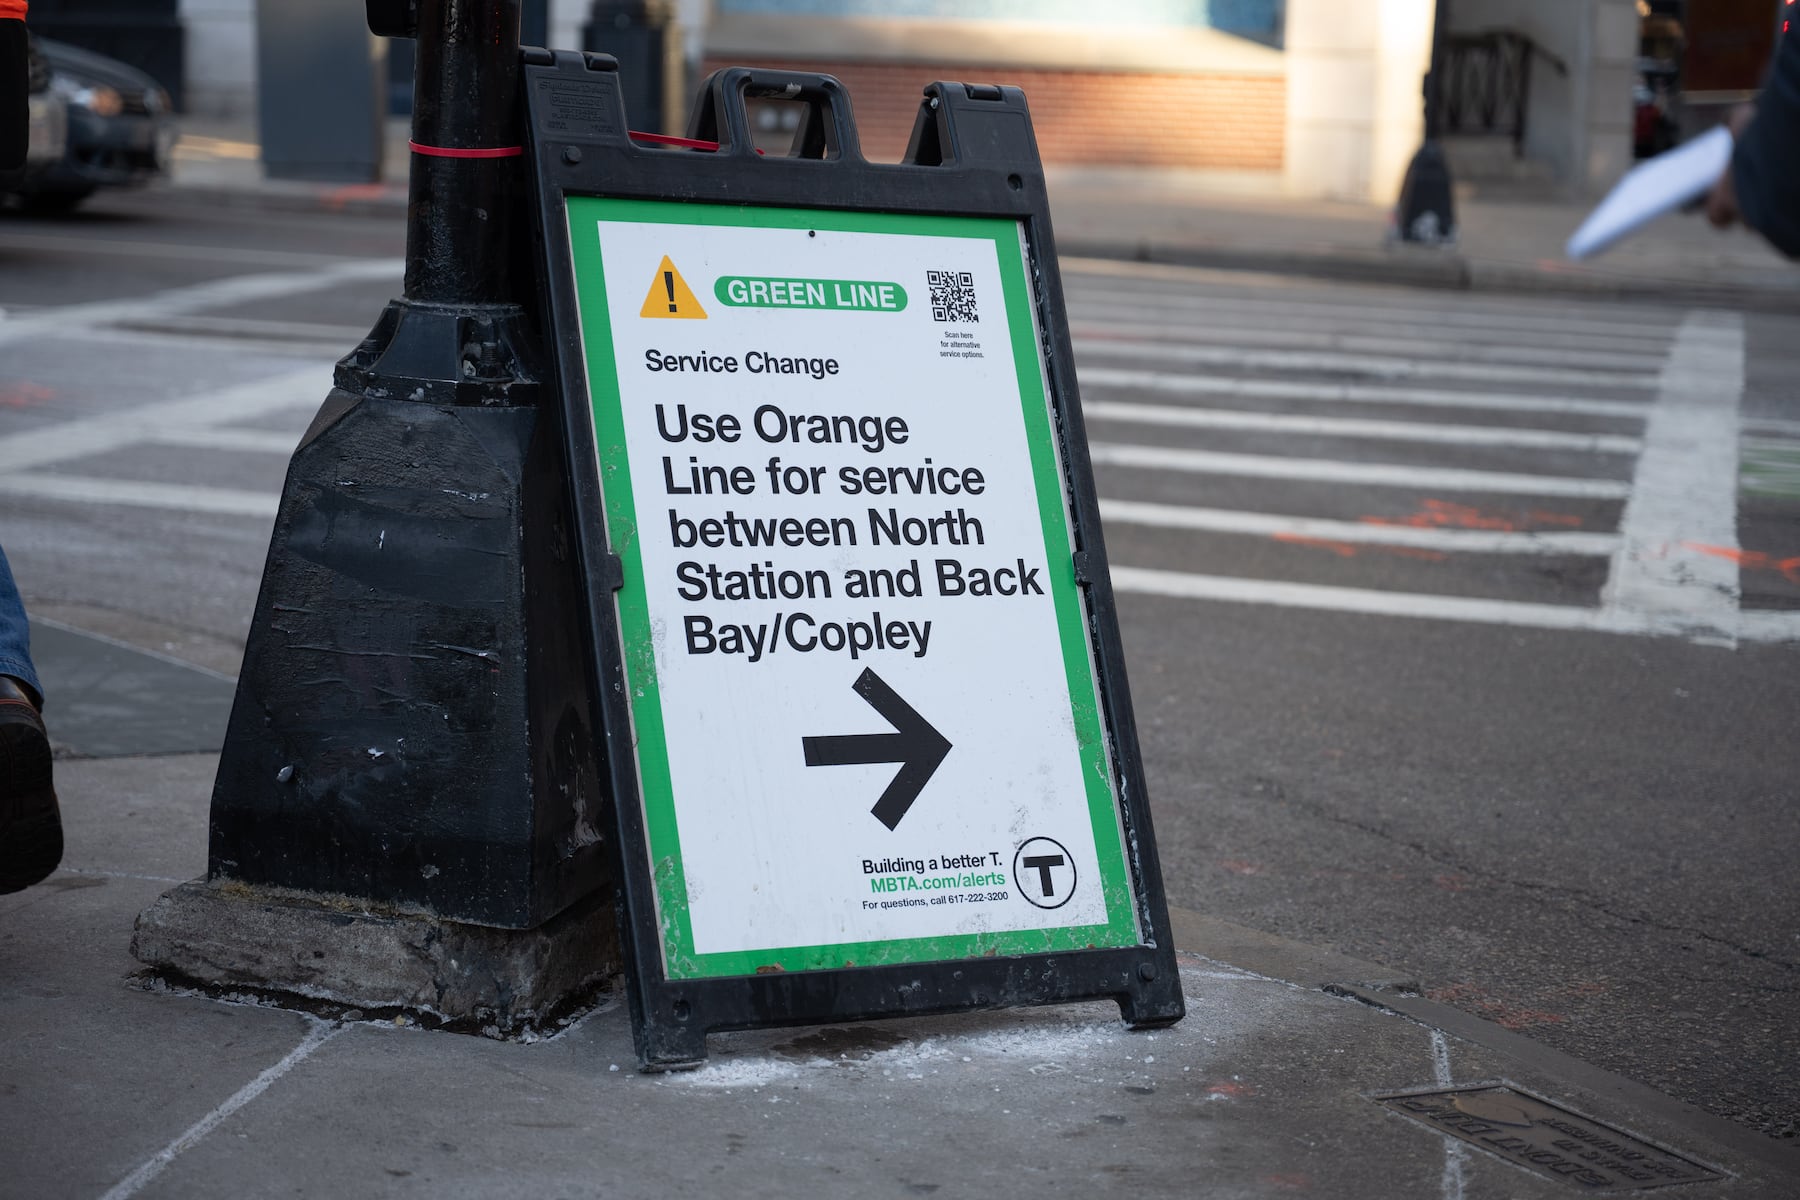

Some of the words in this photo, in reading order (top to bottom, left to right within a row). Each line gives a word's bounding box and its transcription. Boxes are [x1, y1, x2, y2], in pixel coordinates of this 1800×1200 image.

[728, 278, 827, 305] GREEN
[835, 281, 898, 308] LINE
[944, 331, 960, 339] Scan
[950, 341, 981, 349] alternative
[646, 349, 738, 372] Service
[746, 352, 838, 379] Change
[939, 350, 961, 358] service
[961, 351, 984, 360] options.
[655, 404, 741, 442] Use
[754, 405, 908, 453] Orange
[663, 457, 755, 494] Line
[766, 457, 826, 494] for
[839, 458, 984, 495] service
[669, 509, 857, 547] between
[868, 509, 984, 545] North
[677, 561, 831, 601] Station
[845, 560, 922, 598] and
[935, 559, 1044, 596] Back
[684, 612, 931, 662] Bay/Copley
[863, 858, 924, 874] Building
[929, 860, 937, 870] a
[942, 855, 986, 869] better
[989, 852, 1002, 865] T.
[1022, 855, 1064, 897] T
[872, 872, 1006, 893] MBTA.com/alerts
[863, 901, 877, 909] For
[881, 899, 928, 909] questions,
[931, 896, 946, 904] call
[949, 892, 1008, 903] 617-222-3200
